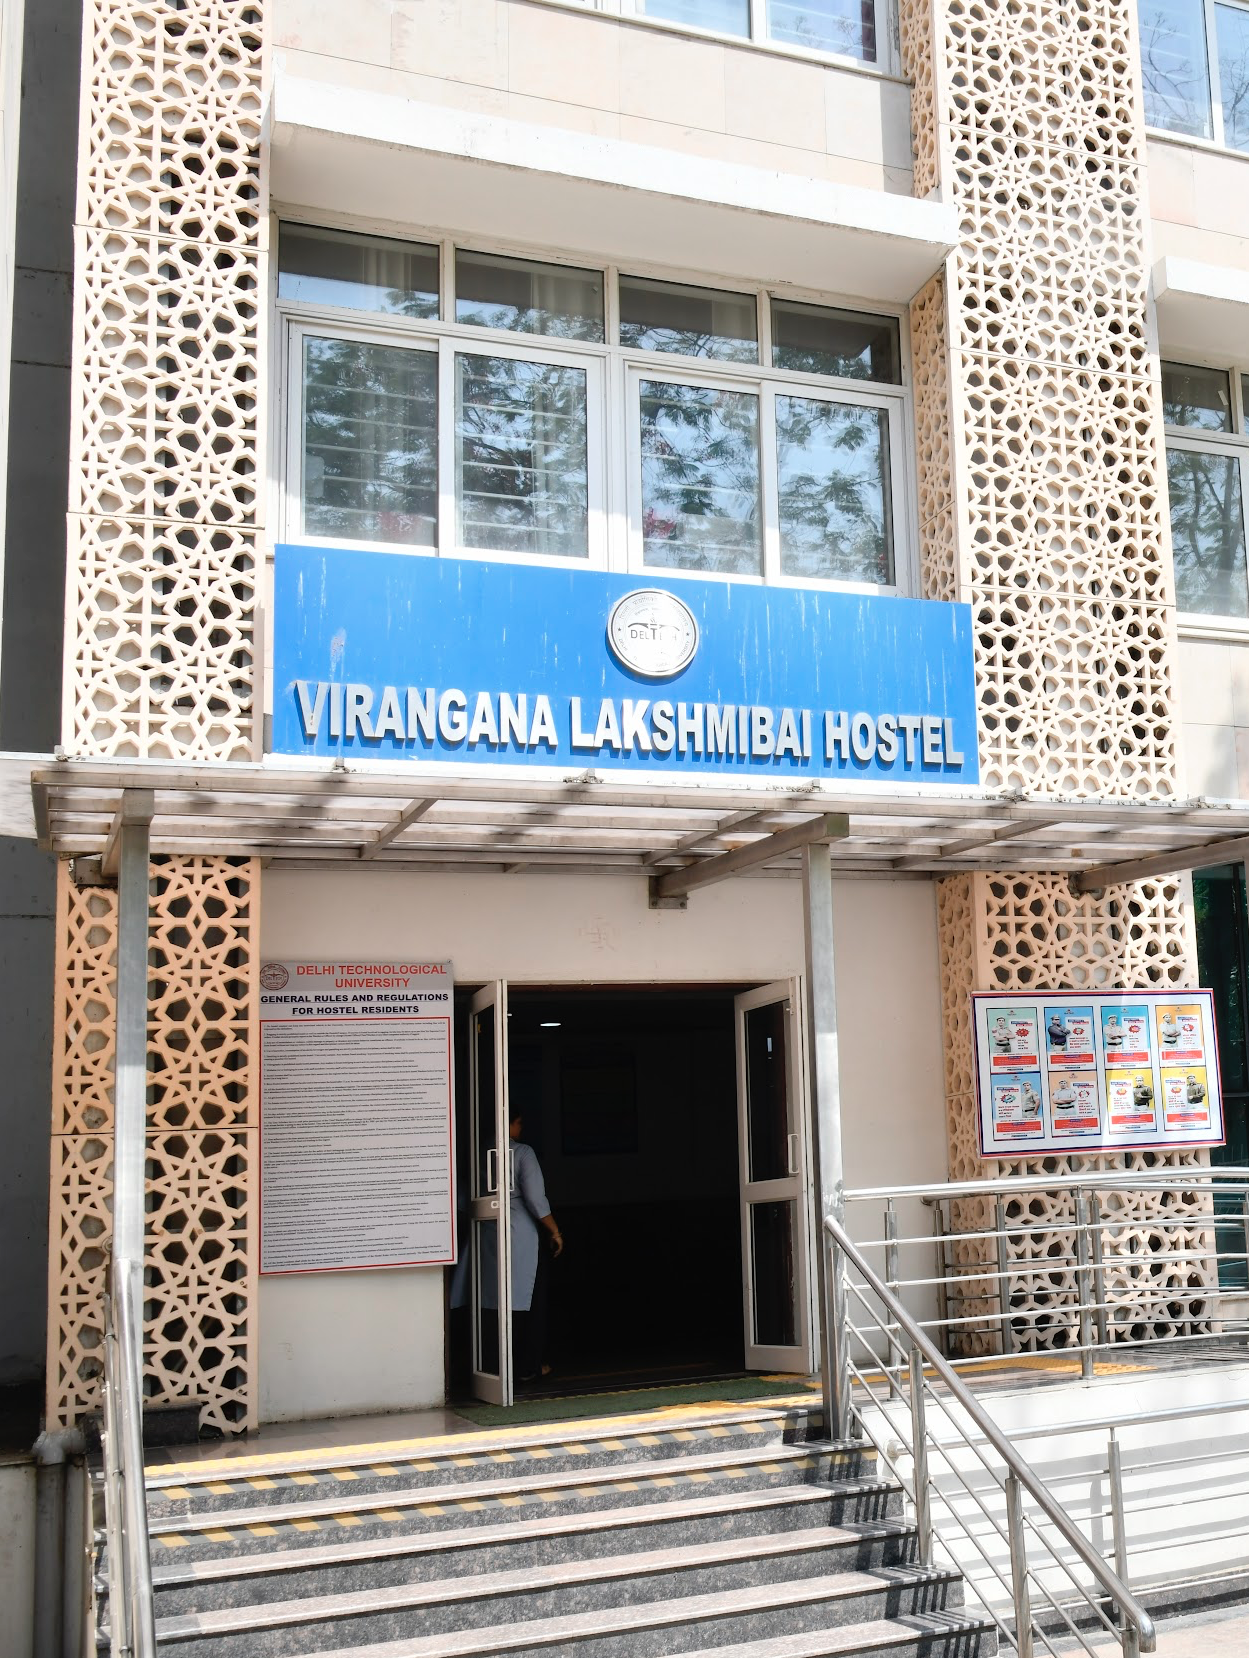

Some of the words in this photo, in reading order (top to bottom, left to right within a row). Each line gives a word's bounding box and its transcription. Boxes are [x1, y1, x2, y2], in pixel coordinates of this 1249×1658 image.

[294, 680, 558, 746] VIRANGANA
[569, 697, 813, 759] LAKSHMIBAI
[824, 710, 964, 765] HOSTEL
[296, 966, 335, 975] DELHI
[339, 965, 447, 975] TECHNOLOGICAL
[335, 978, 410, 988] UNIVERSITY
[261, 995, 311, 1003] GENERAL
[314, 994, 348, 1002] RULES
[352, 994, 374, 1002] AND
[377, 993, 449, 1002] REGULATIONS
[292, 1007, 313, 1015] FOR
[317, 1006, 358, 1014] HOSTEL
[362, 1005, 419, 1014] RESIDENTS
